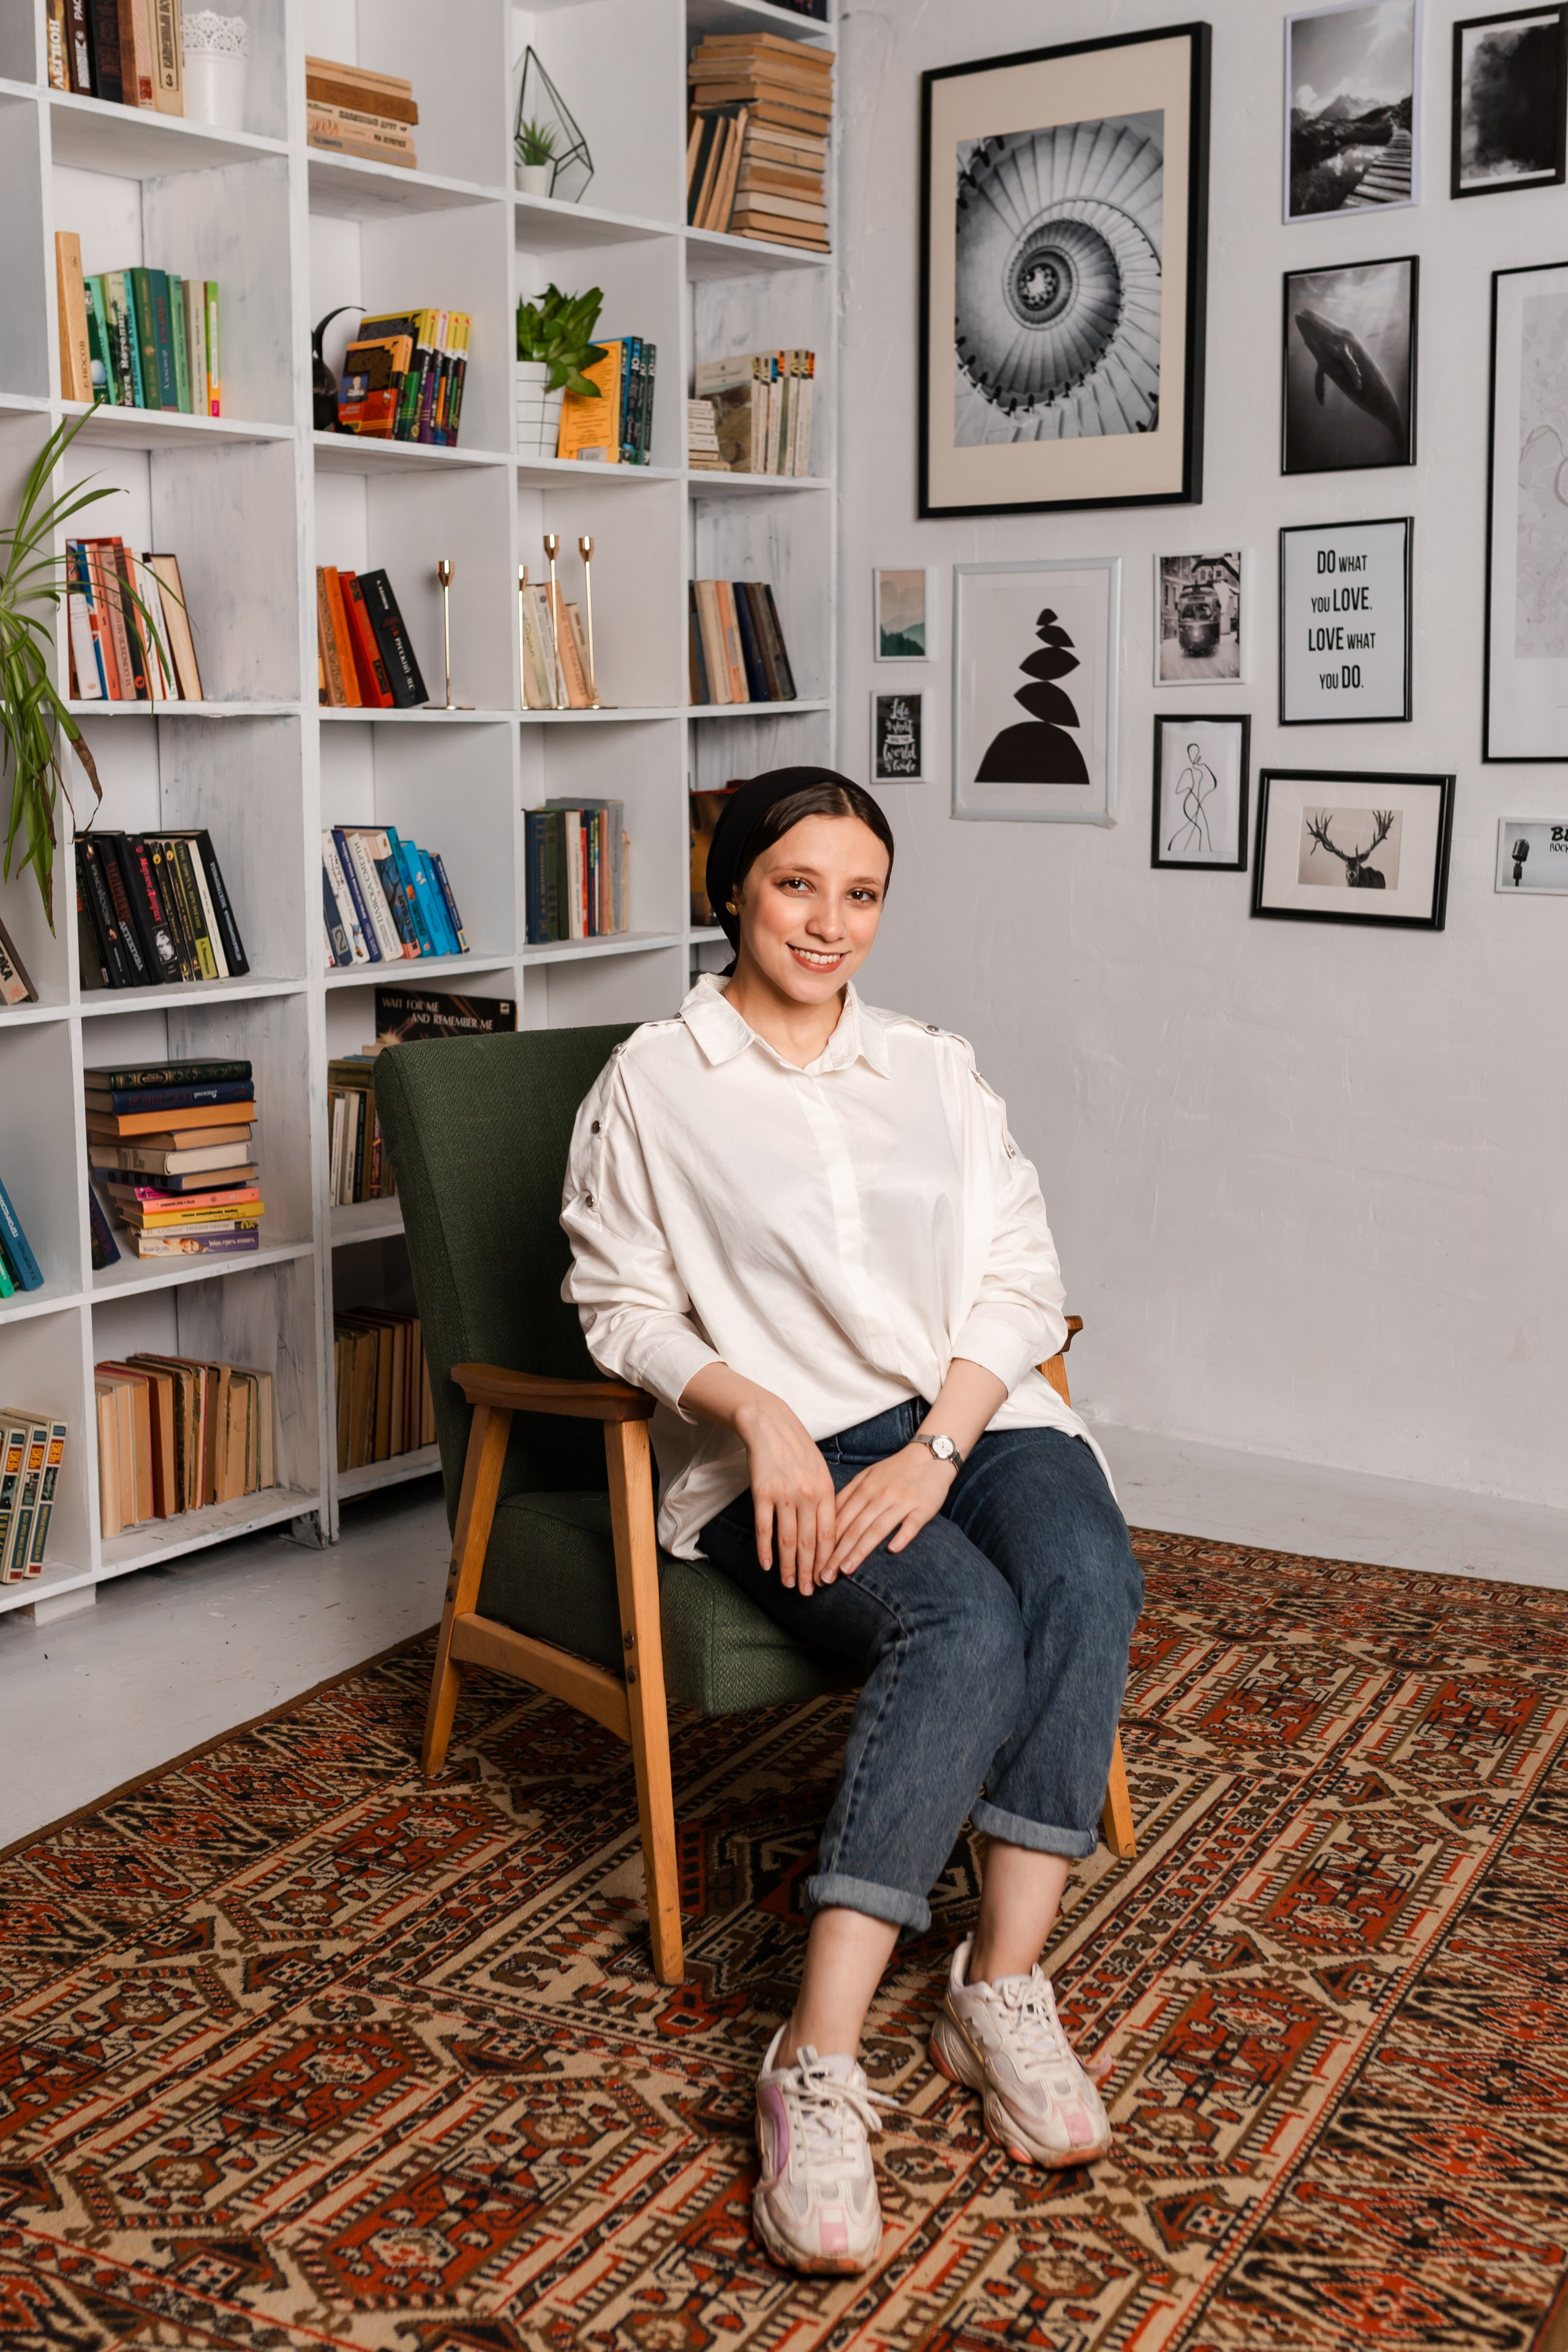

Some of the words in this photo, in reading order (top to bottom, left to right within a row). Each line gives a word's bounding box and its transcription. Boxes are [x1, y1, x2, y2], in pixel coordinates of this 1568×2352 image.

[124, 375, 134, 407] Катя
[1317, 549, 1336, 574] DO
[1338, 555, 1368, 573] WHAT
[1311, 597, 1330, 613] YOU
[1333, 587, 1373, 612] LOVE.
[1308, 627, 1344, 652] LOVE
[1347, 632, 1376, 650] WHAT
[395, 637, 412, 673] РУССКИЙ
[1319, 673, 1339, 690] YOU
[1341, 664, 1364, 688] DO.
[354, 842, 370, 883] СМЕРТИ
[368, 886, 385, 923] ПЛЯСКА
[382, 998, 403, 1009] WAIT
[406, 999, 423, 1011] FOR
[426, 1001, 440, 1012] ME
[411, 1012, 429, 1023] AND
[433, 1014, 477, 1028] REMEMBER
[480, 1019, 494, 1030] ME
